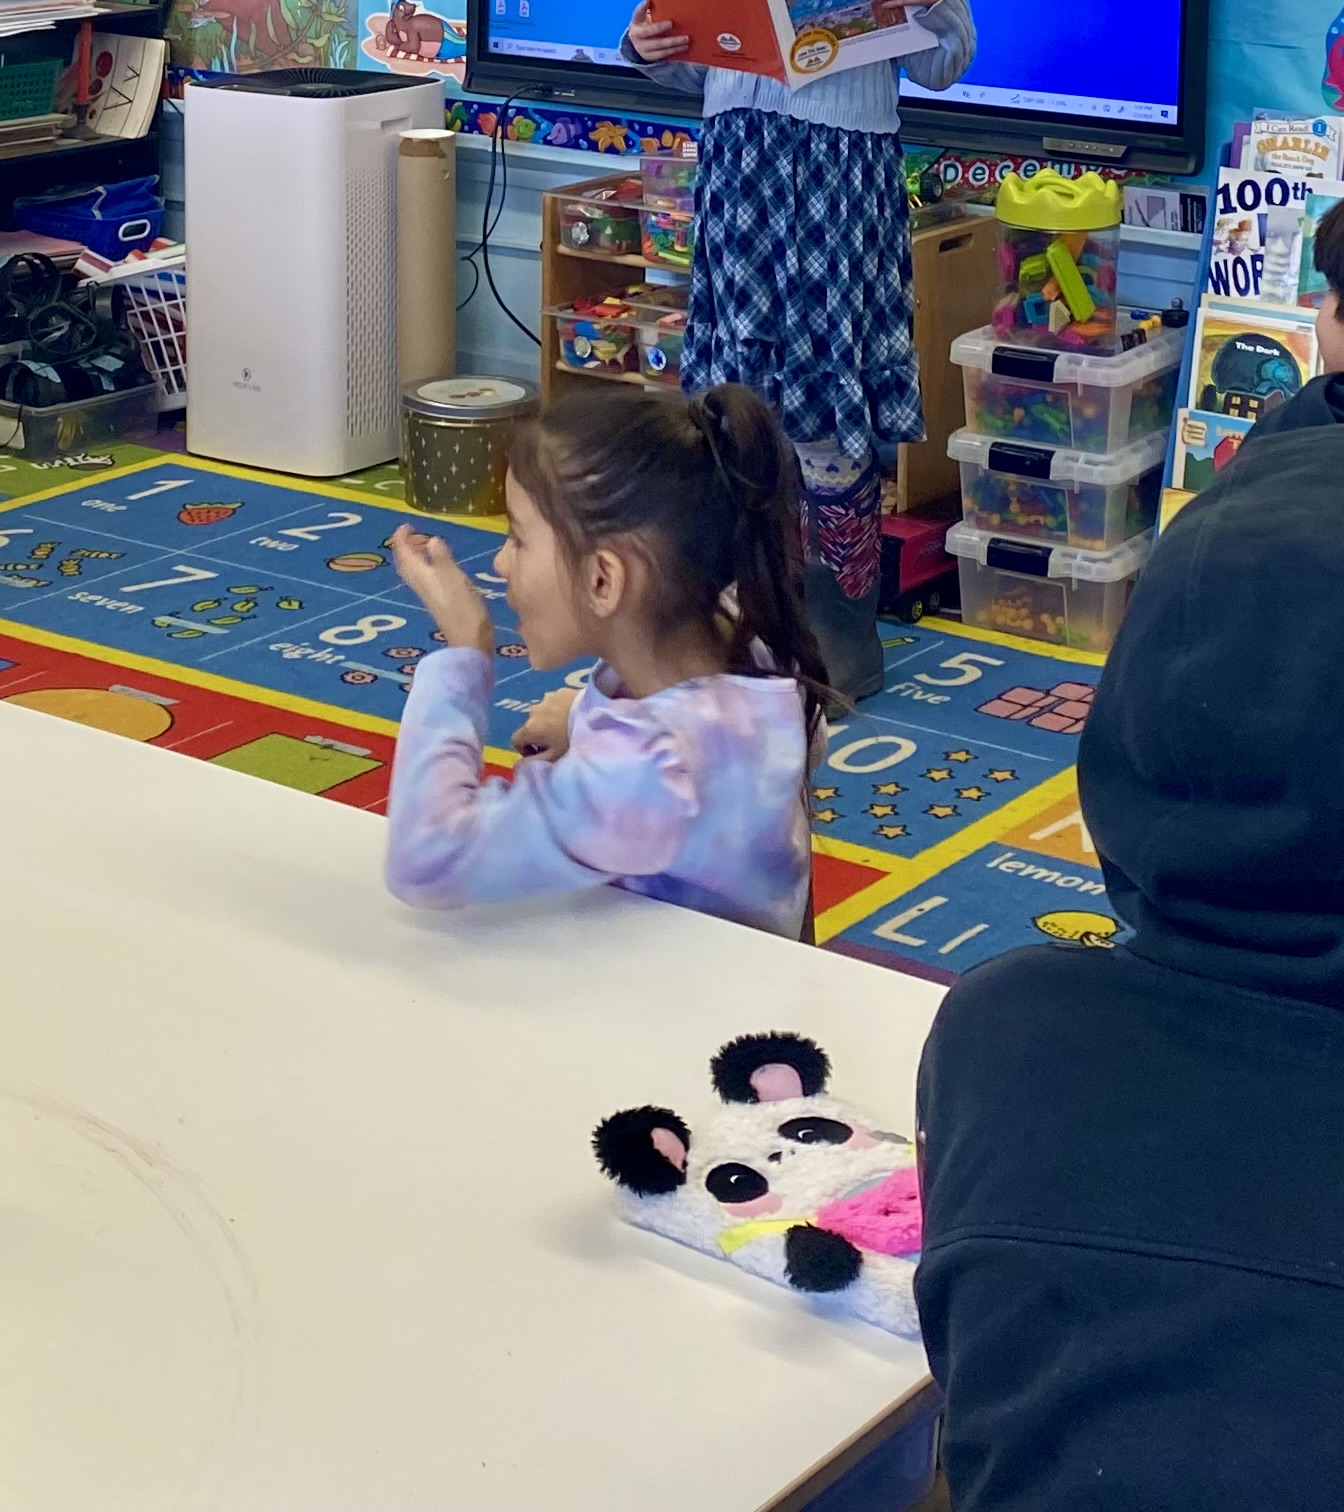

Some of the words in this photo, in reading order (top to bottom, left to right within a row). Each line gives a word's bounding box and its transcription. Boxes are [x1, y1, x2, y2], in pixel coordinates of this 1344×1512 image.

[1217, 177, 1313, 214] 100th
[1235, 341, 1255, 352] The
[1256, 344, 1280, 356] Dark
[68, 590, 143, 615] seven
[268, 641, 347, 667] eight
[886, 682, 951, 704] five
[987, 852, 1105, 895] lemon
